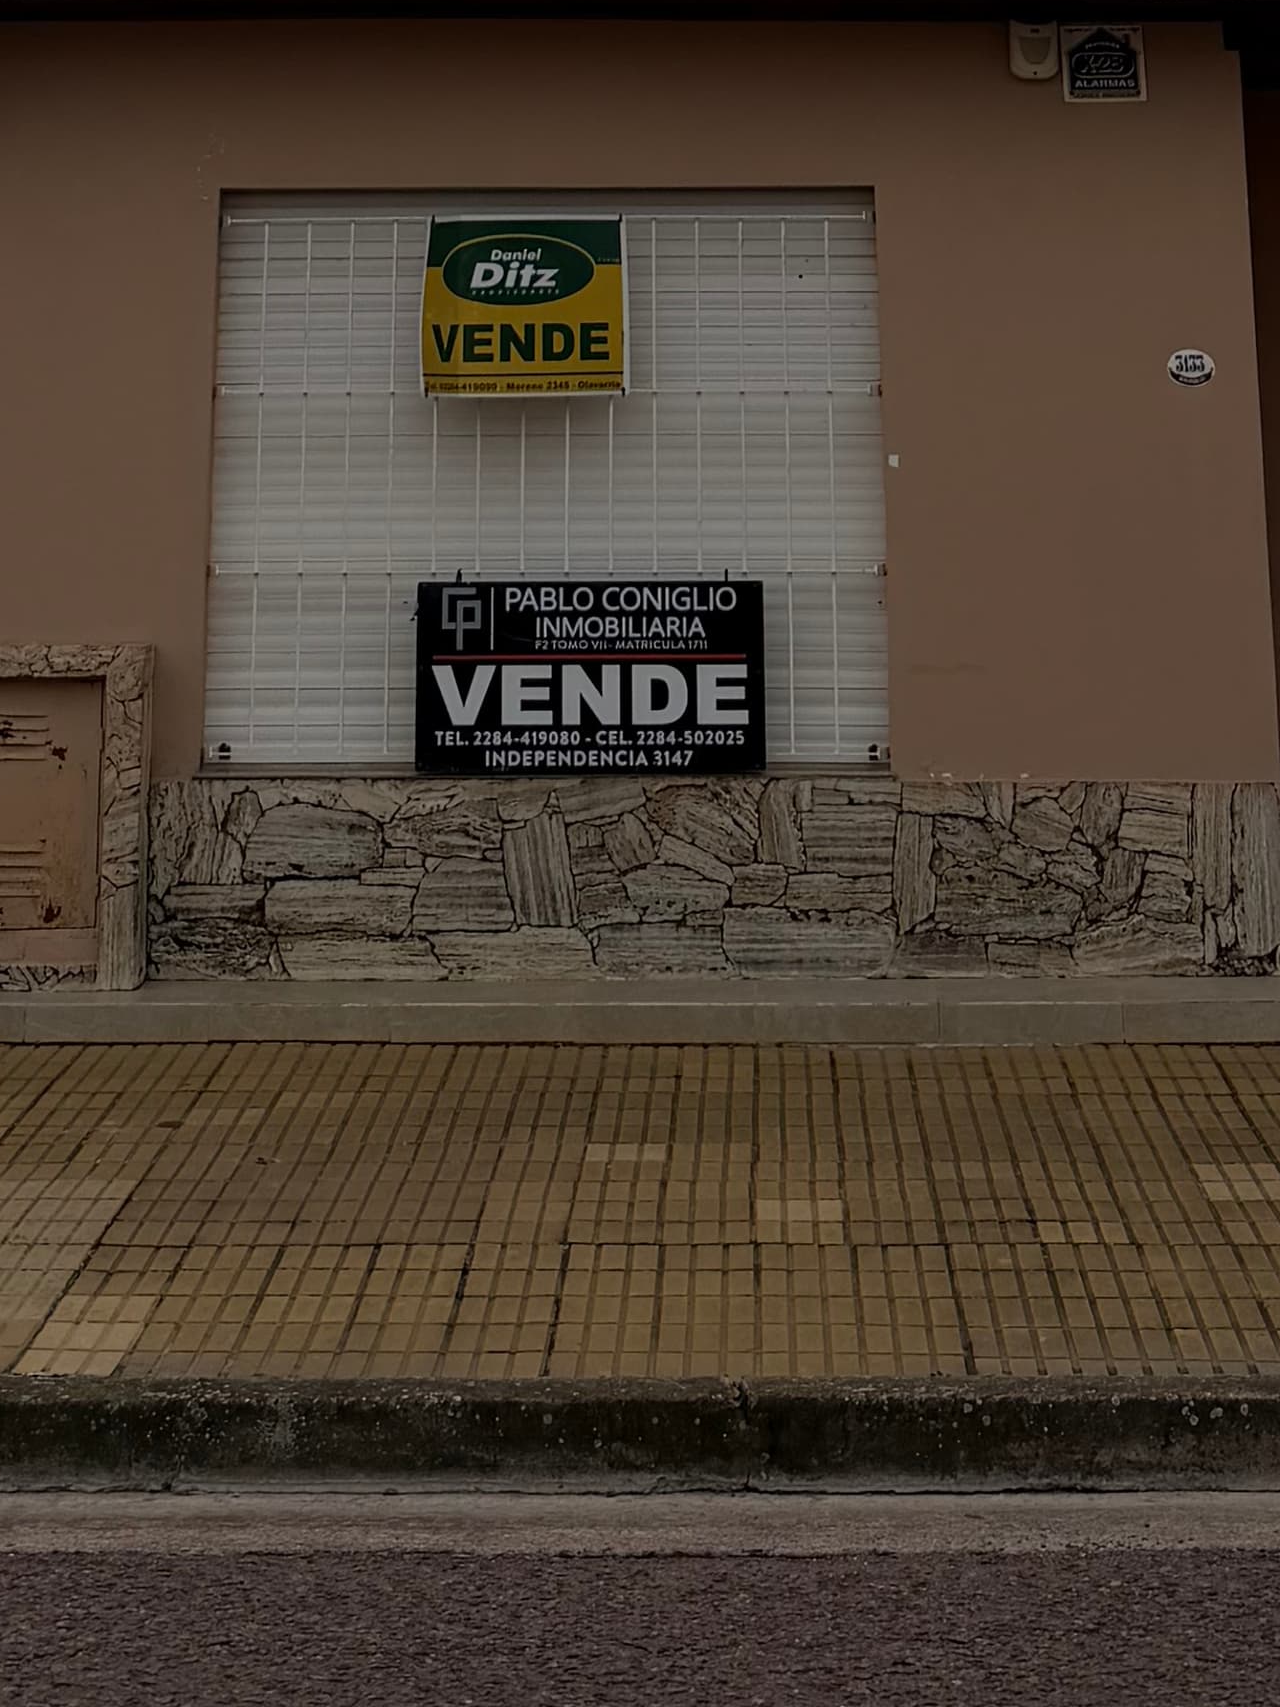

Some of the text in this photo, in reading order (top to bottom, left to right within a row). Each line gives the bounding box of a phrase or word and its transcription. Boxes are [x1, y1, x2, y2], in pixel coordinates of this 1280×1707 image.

[1075, 79, 1135, 89] ALARMAS
[490, 248, 542, 262] Daniel
[470, 260, 560, 289] Ditz
[432, 322, 610, 363] VENDE
[1175, 354, 1205, 372] 3133
[505, 586, 737, 612] PABLO CONIGLIO
[535, 616, 707, 638] INMOBILIARIA
[550, 640, 590, 650] TOMO
[616, 640, 686, 650] MATRICULA
[688, 640, 708, 650] 1711
[431, 664, 750, 726] VENDE
[434, 730, 469, 747] TEL.
[472, 730, 581, 747] 2284-419080
[595, 730, 633, 746] CEL.
[636, 730, 745, 746] 2284-502025
[485, 749, 694, 768] INDEPENDENCIA 3147
